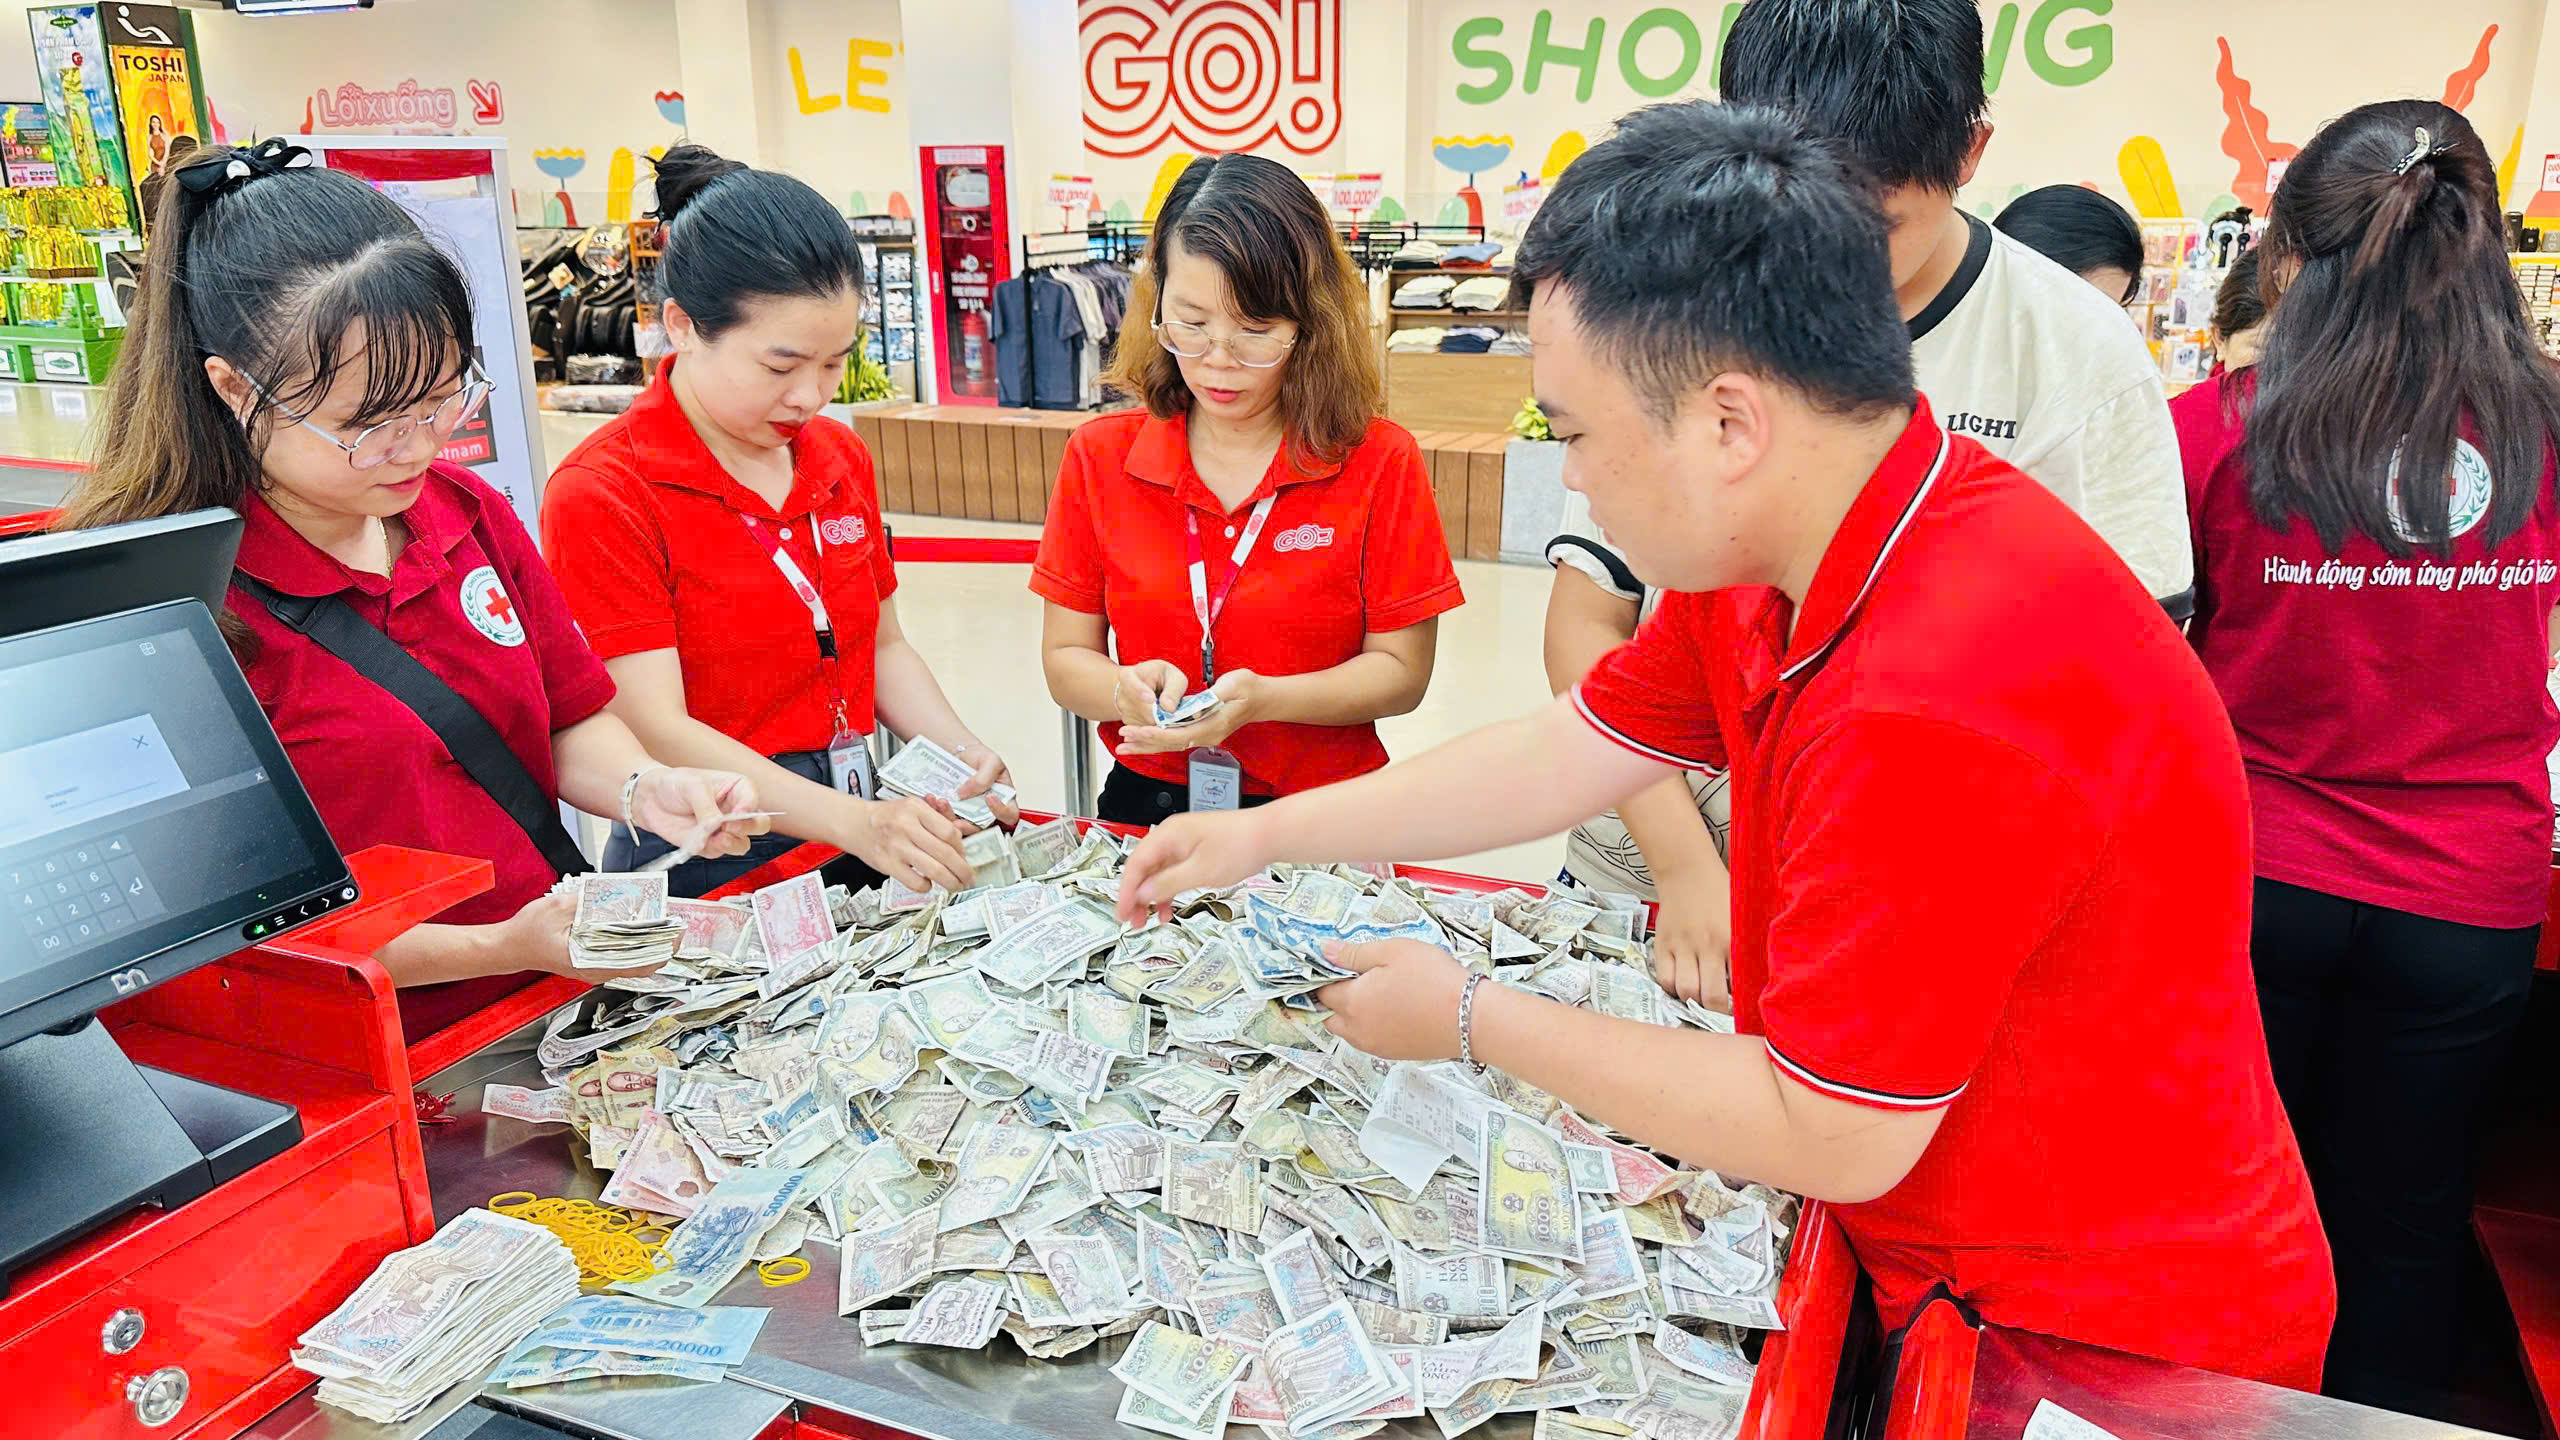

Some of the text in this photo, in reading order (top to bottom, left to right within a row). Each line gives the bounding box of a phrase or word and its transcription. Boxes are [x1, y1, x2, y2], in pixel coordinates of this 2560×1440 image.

[119, 54, 183, 73] TOSHI
[788, 38, 904, 114] LE
[148, 73, 185, 83] JAPAN
[1079, 0, 1341, 158] GO!
[1947, 412, 2017, 439] LIGHT
[2263, 555, 2312, 584] Hành
[2315, 558, 2366, 590] động
[2368, 559, 2411, 586] sớm
[2416, 559, 2457, 591] ứng
[2457, 559, 2499, 591] phó
[2498, 558, 2536, 591] gió
[45, 861, 55, 874] 8
[78, 851, 88, 863] 9
[57, 882, 67, 894] 5
[89, 871, 99, 883] 6
[68, 903, 78, 915] 2
[101, 892, 111, 904] 3
[43, 924, 90, 949] 00 0
[763, 1174, 804, 1217] 500000
[1303, 1314, 1342, 1339] 2000
[655, 1339, 722, 1358] 20000
